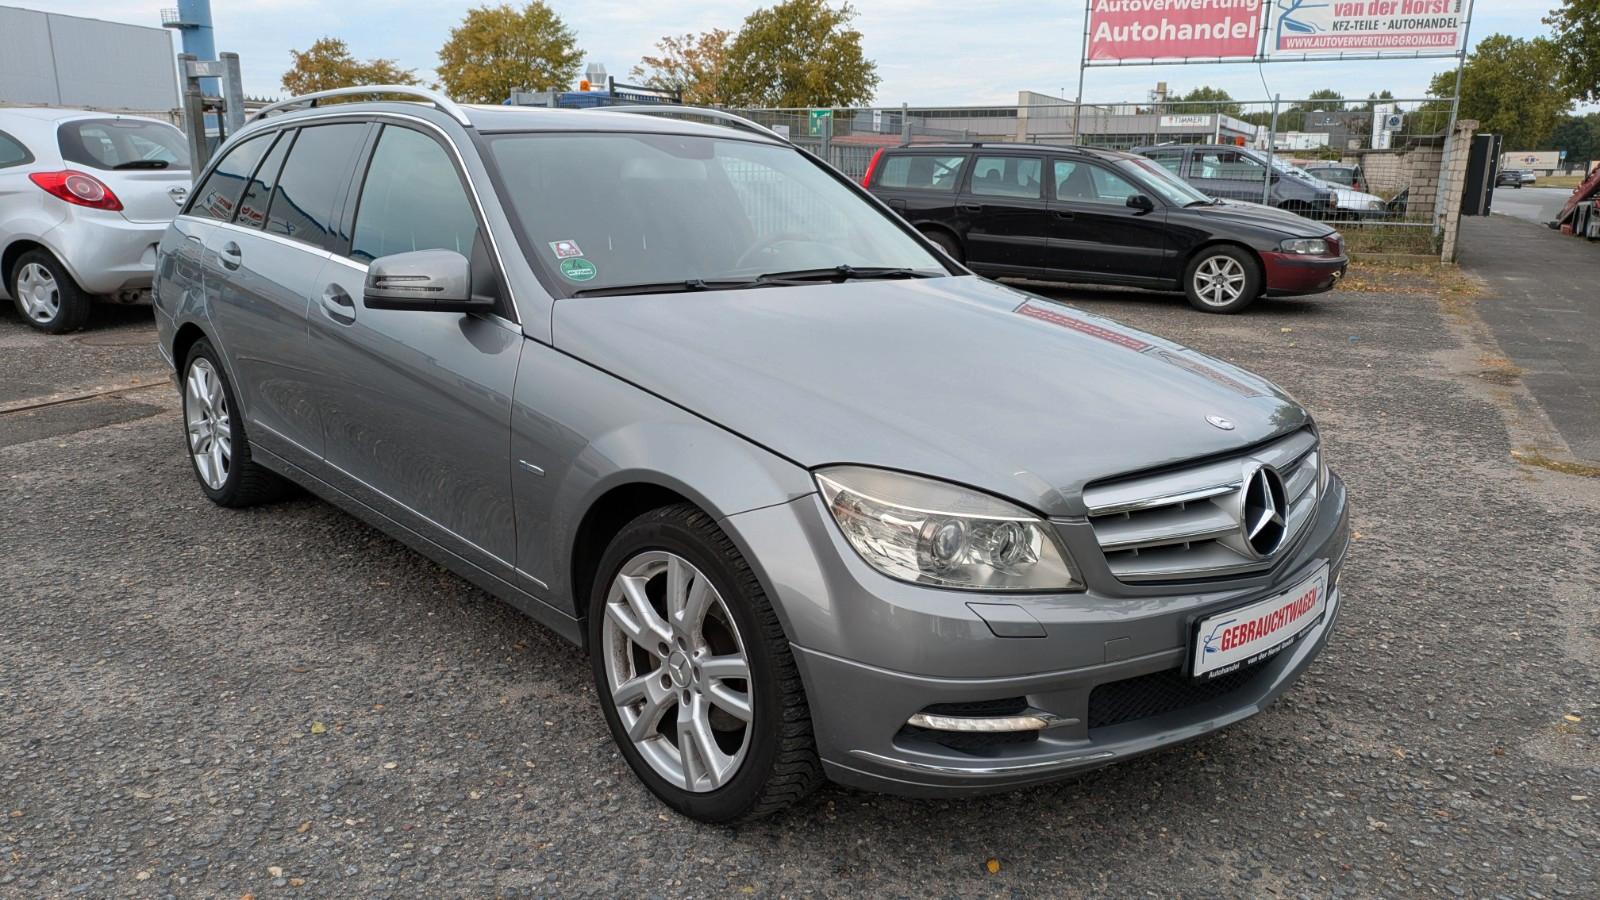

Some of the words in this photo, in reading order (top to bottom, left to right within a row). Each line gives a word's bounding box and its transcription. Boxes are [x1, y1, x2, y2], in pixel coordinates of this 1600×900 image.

[1095, 0, 1258, 12] Autoverwertung
[1334, 2, 1365, 17] van
[1368, 0, 1398, 16] der
[1401, 0, 1450, 15] Horst
[1093, 15, 1257, 42] Autohandel
[1332, 20, 1379, 31] KFZ-TEILE
[1388, 17, 1458, 30] AUTOHANDEL
[1286, 34, 1454, 48] WWW.AUTOVERWERTUNGGRONAU.DE
[1221, 586, 1318, 652] GEBRAUCHTWAGEN
[1208, 663, 1240, 679] Autohandel
